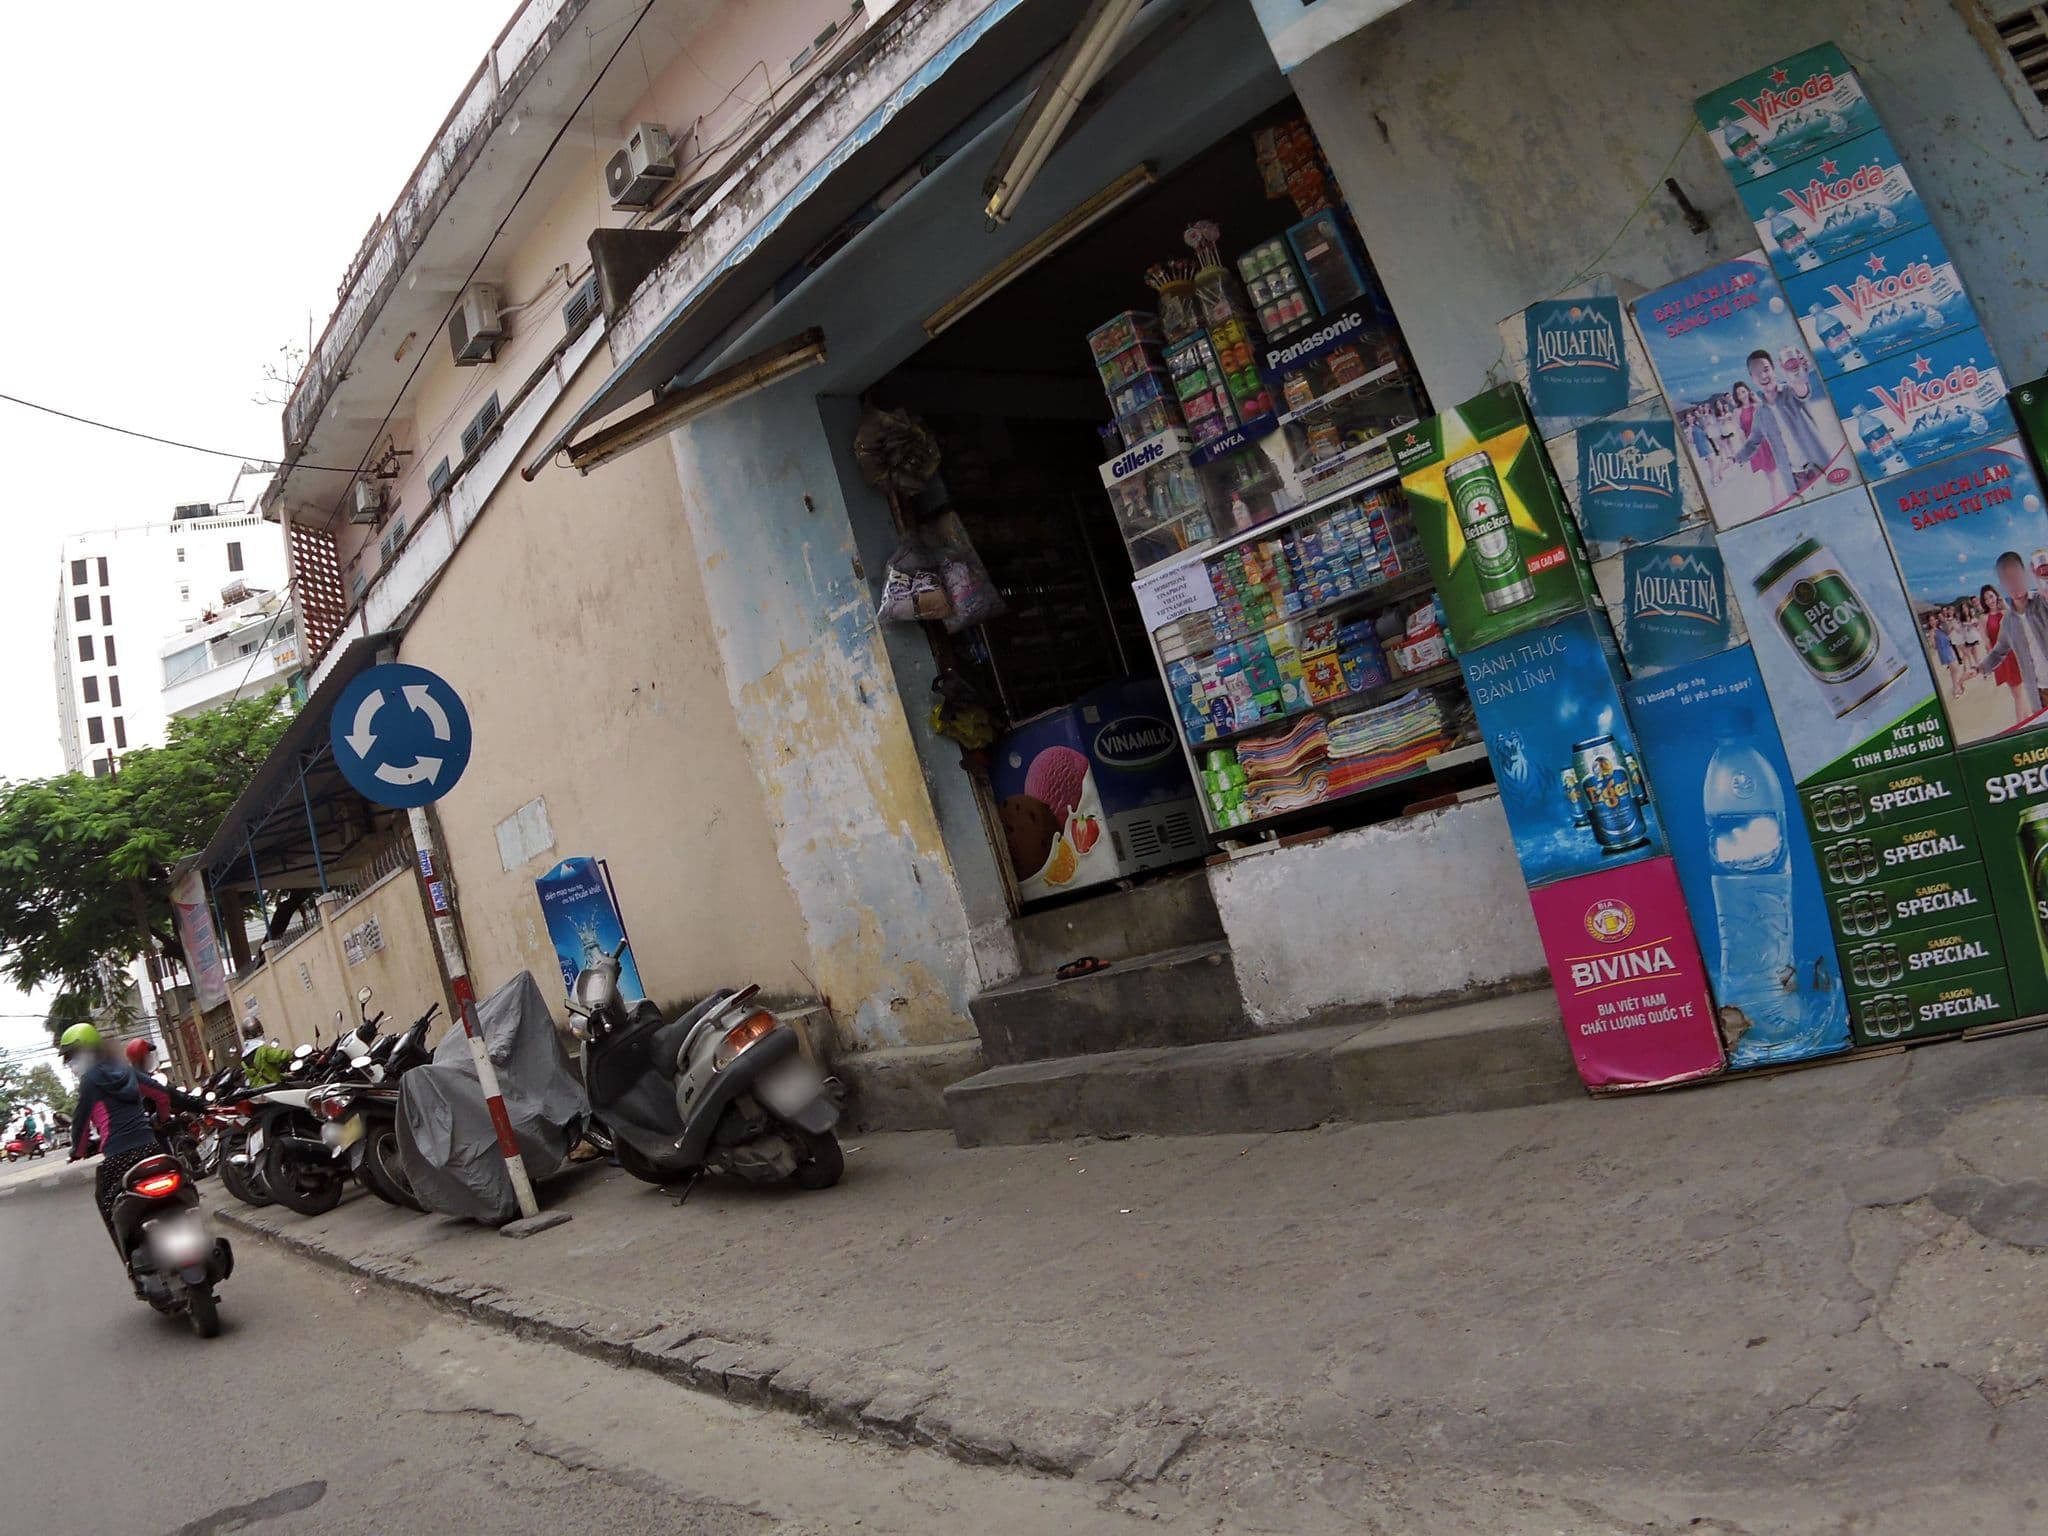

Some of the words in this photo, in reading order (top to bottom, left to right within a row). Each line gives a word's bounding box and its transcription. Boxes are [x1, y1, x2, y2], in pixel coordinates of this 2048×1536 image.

[1732, 73, 1836, 131] Vikoda
[1779, 164, 1886, 223] Vikoda
[1824, 262, 1935, 321] Vikoda
[1266, 311, 1363, 370] Panasonic
[1536, 320, 1620, 369] AQUAFINA
[1868, 364, 1980, 426] Vikoda
[1112, 442, 1165, 479] Gillette
[1212, 434, 1246, 455] NIVEA
[1588, 447, 1675, 493] AQUAFINA
[1899, 488, 1931, 514] BẬT
[1934, 478, 1971, 503] LỊCH
[1974, 463, 2012, 488] LÃM
[1911, 504, 1957, 531] SÁNG
[1959, 497, 1982, 518] TỰ
[1984, 486, 2014, 508] TIN
[1464, 515, 1510, 540] Heineken
[1634, 570, 1721, 621] AQUAFINA
[1804, 601, 1831, 621] BIA
[1794, 596, 1864, 655] SAIGON
[1469, 655, 1517, 682] ĐÁNH
[1519, 634, 1568, 662] THỨC
[1475, 677, 1515, 705] BẢN
[1515, 666, 1556, 693] LĨNH
[1101, 727, 1170, 755] VINAMILK
[1893, 721, 1916, 741] KẾT
[1917, 716, 1940, 736] NỐI
[1852, 749, 1882, 769] TÌNH
[1884, 740, 1917, 762] BẰNG
[1919, 732, 1945, 751] HỮU
[1586, 777, 1631, 808] Tiger
[1870, 781, 1952, 814] SPECIAL
[1888, 775, 1925, 790] SAIGON
[1883, 834, 1966, 867] SPECIAL
[1902, 829, 1938, 844] SAIGON
[1896, 888, 1978, 919] SPECIAL
[1915, 882, 1951, 897] SAIGON
[1908, 941, 1990, 971] SPECIAL
[1927, 935, 1964, 950] SAIGON
[1571, 946, 1677, 988] BIVINA
[1597, 1004, 1617, 1016] BIA
[1617, 997, 1641, 1013] VIỆT
[1642, 993, 1668, 1007] NAM
[1919, 994, 2000, 1022] SPECIAL
[1939, 987, 1974, 1001] SAIGON
[1580, 1016, 1608, 1036] CHẤT
[1648, 1006, 1679, 1024] QUỐC
[1679, 1001, 1695, 1018] TẾ
